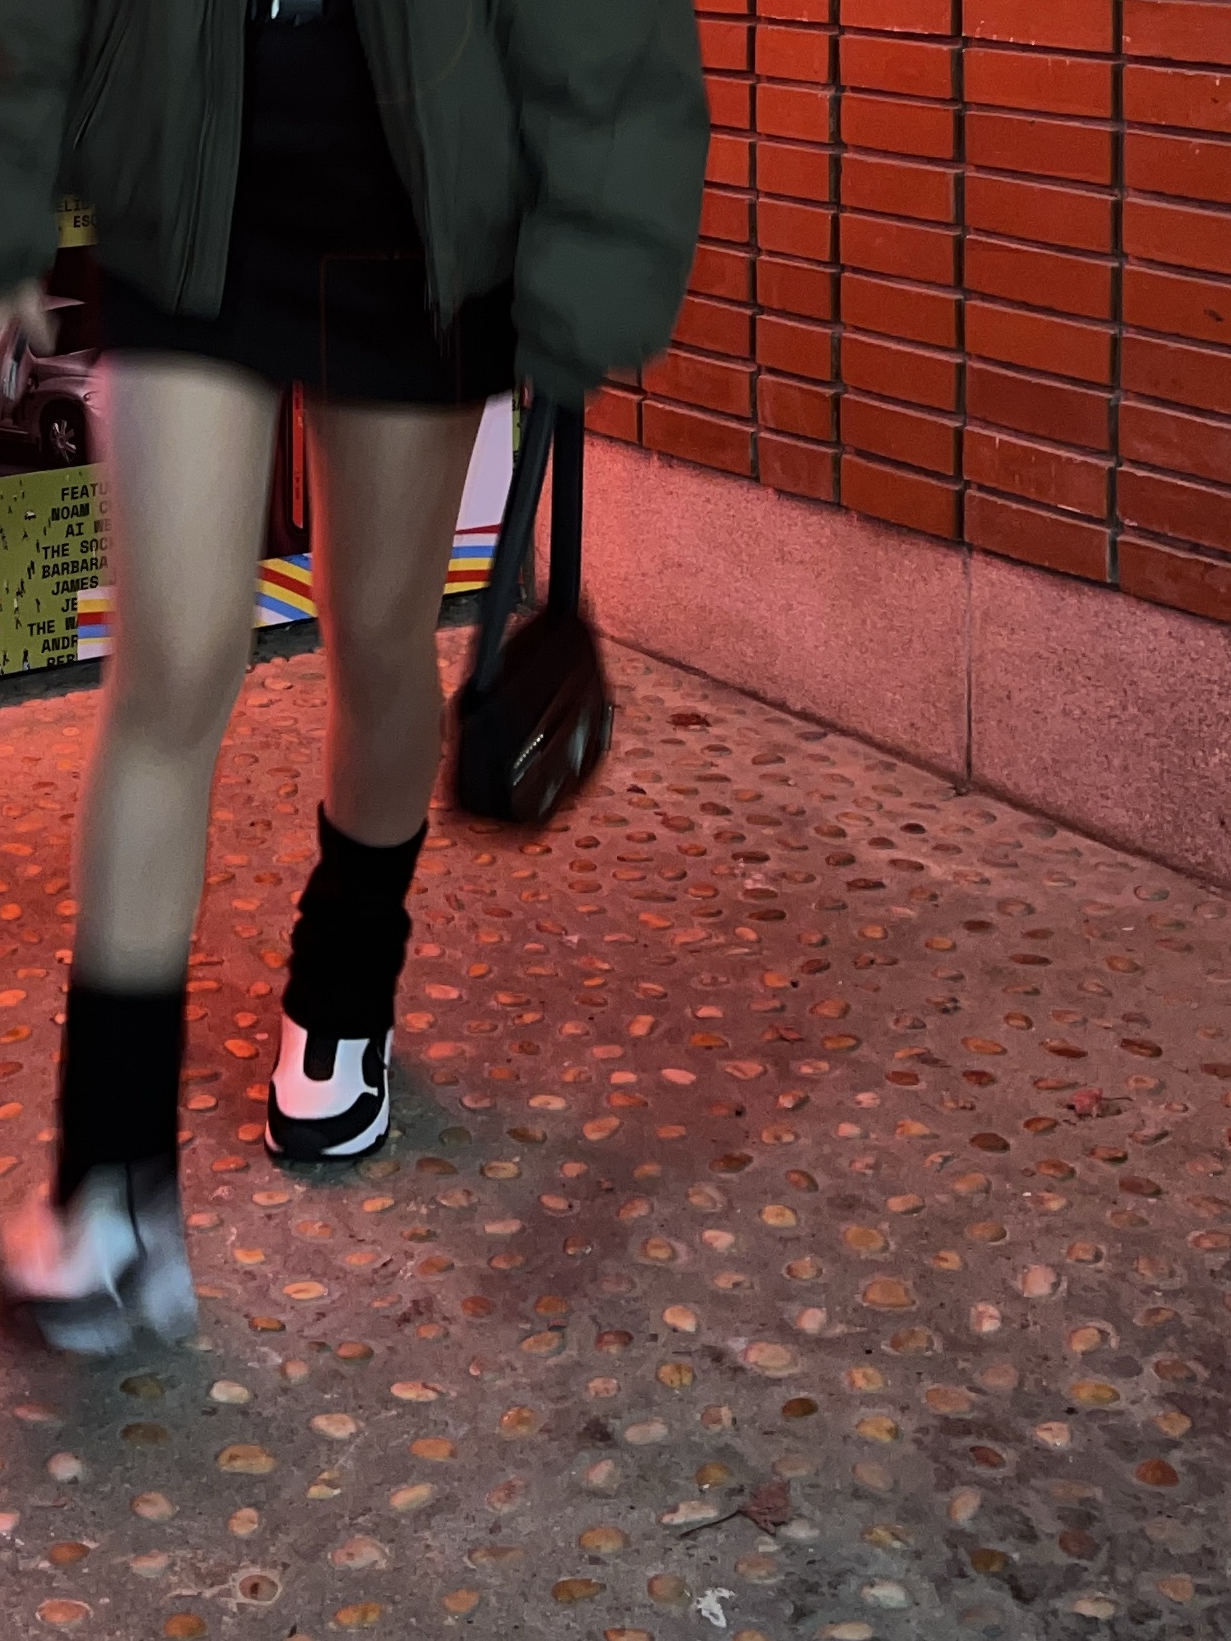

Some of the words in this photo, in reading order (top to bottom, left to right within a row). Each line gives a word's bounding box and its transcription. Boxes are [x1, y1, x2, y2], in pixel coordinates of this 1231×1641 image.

[51, 503, 90, 523] NOAM
[65, 522, 85, 539] AI
[42, 543, 70, 561] THE
[41, 555, 110, 580] BARBARA
[51, 574, 100, 597] JAMES
[27, 619, 57, 638] THE
